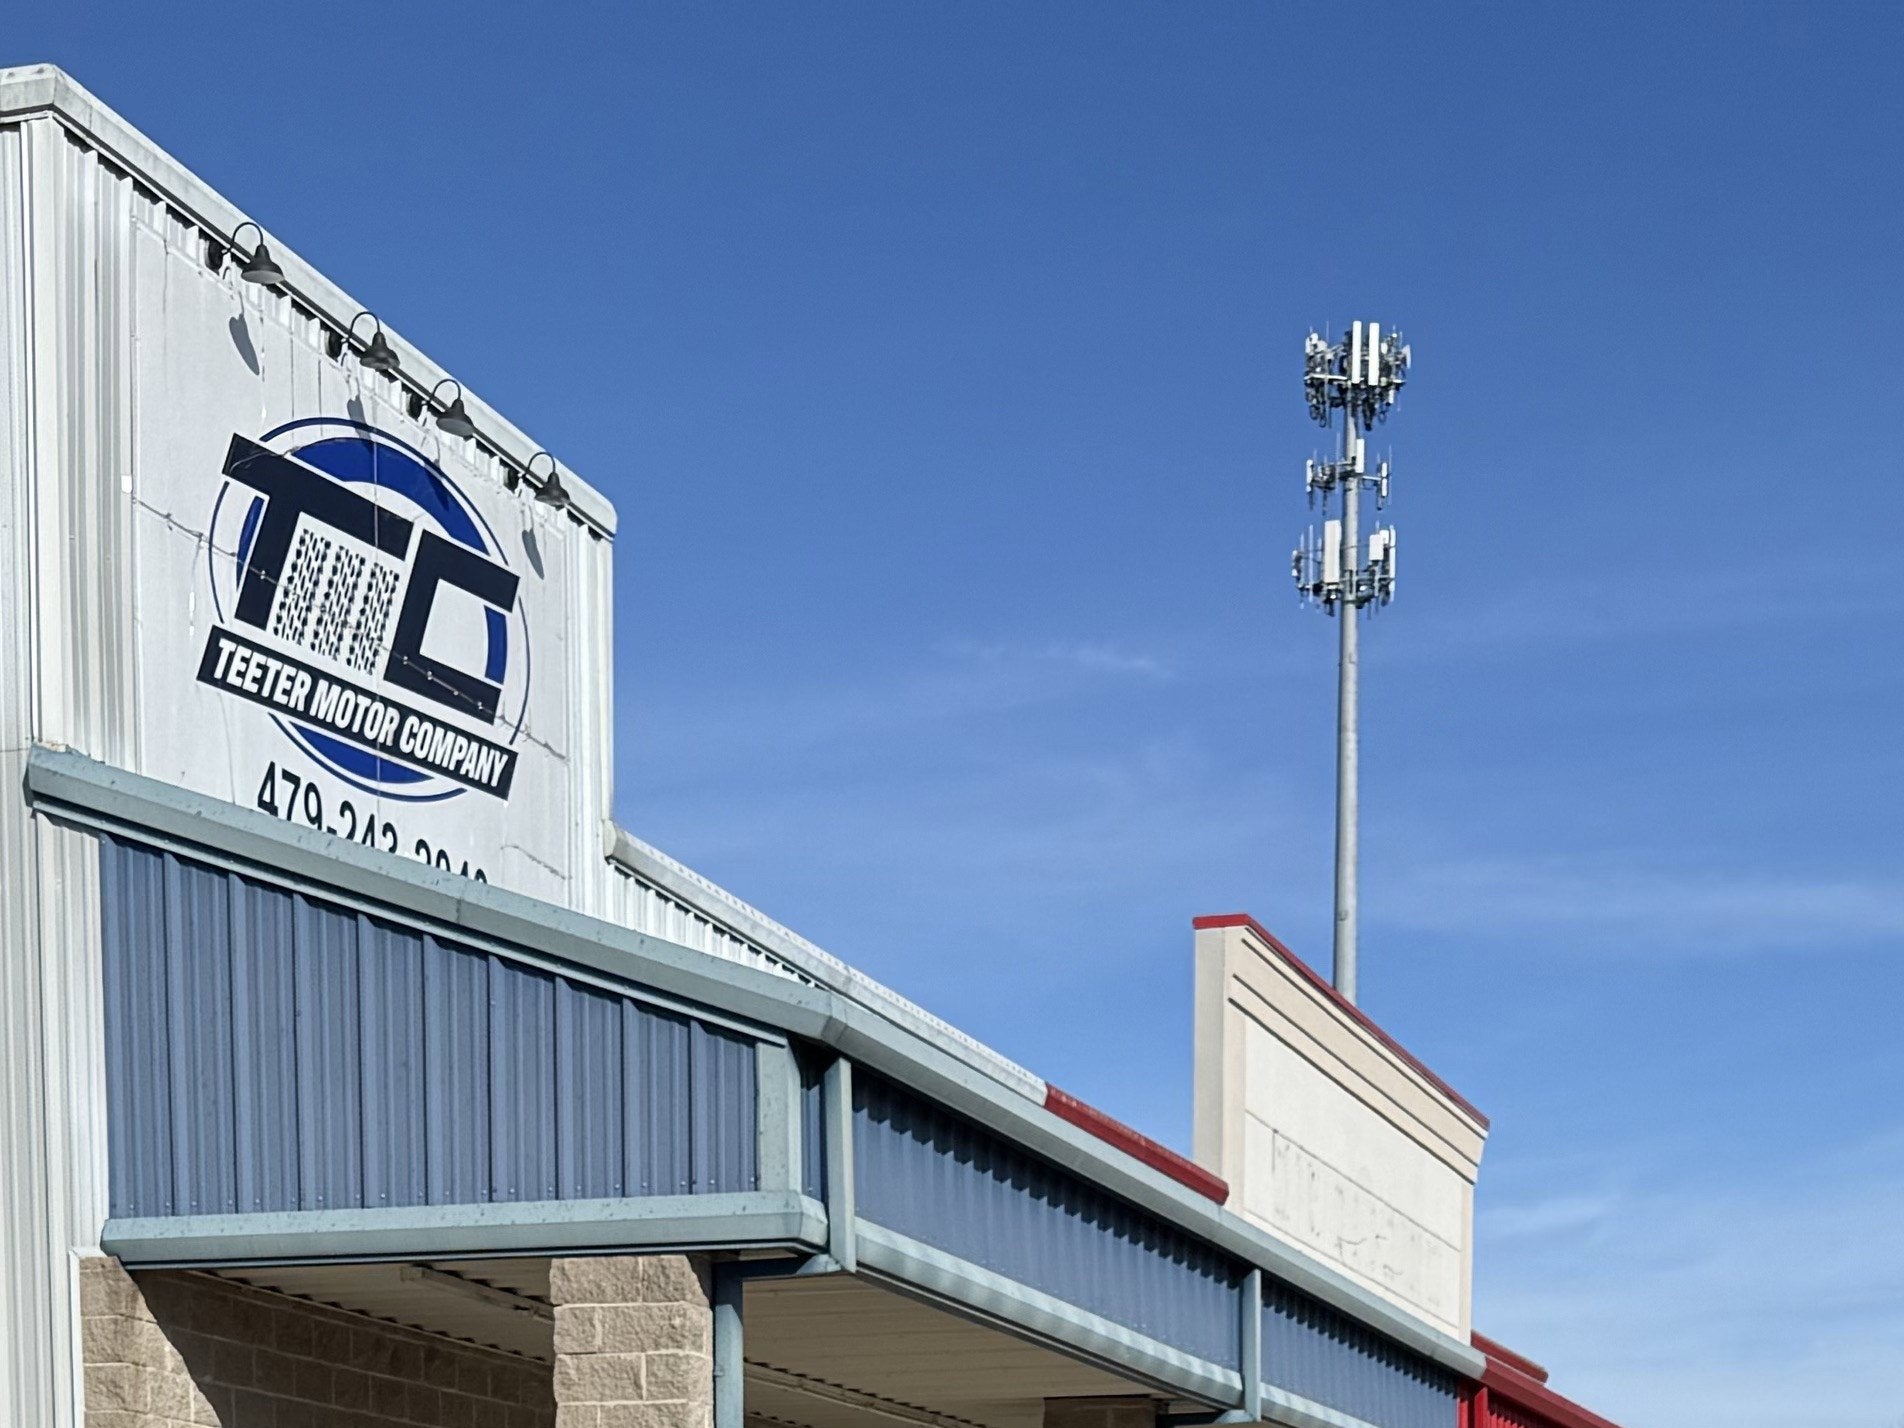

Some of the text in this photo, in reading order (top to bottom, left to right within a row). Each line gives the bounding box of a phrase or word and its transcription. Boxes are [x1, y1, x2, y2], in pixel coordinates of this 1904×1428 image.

[214, 638, 509, 788] TEETER MOTOR COMPANY
